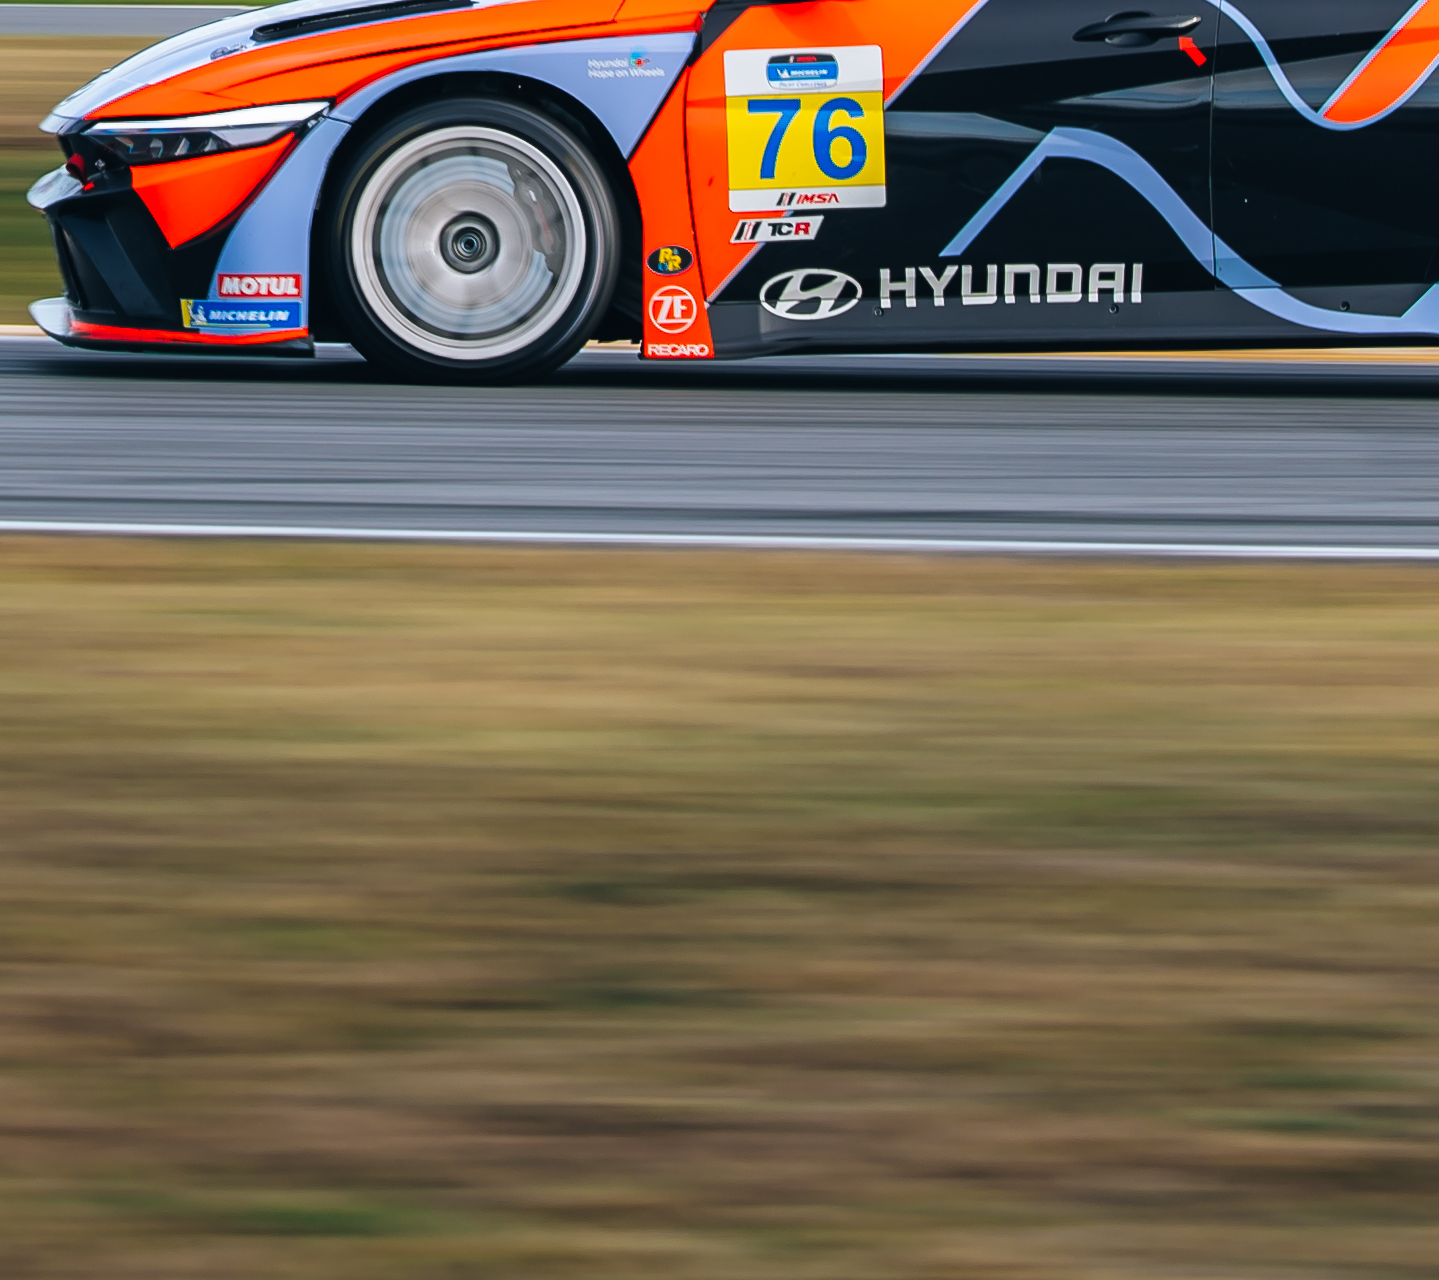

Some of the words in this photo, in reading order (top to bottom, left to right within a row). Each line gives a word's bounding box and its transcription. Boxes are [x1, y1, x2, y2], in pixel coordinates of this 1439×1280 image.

[587, 58, 629, 70] Hyundai
[587, 69, 615, 79] Hope
[629, 67, 666, 78] Wheels
[747, 97, 868, 181] 76
[796, 192, 840, 205] IMSA
[767, 221, 811, 237] TCR
[222, 276, 300, 296] MOTUL
[879, 263, 1143, 309] HYUNDAI
[208, 309, 291, 322] MICHELIN
[653, 295, 692, 324] ZF
[647, 343, 710, 357] RECARO
